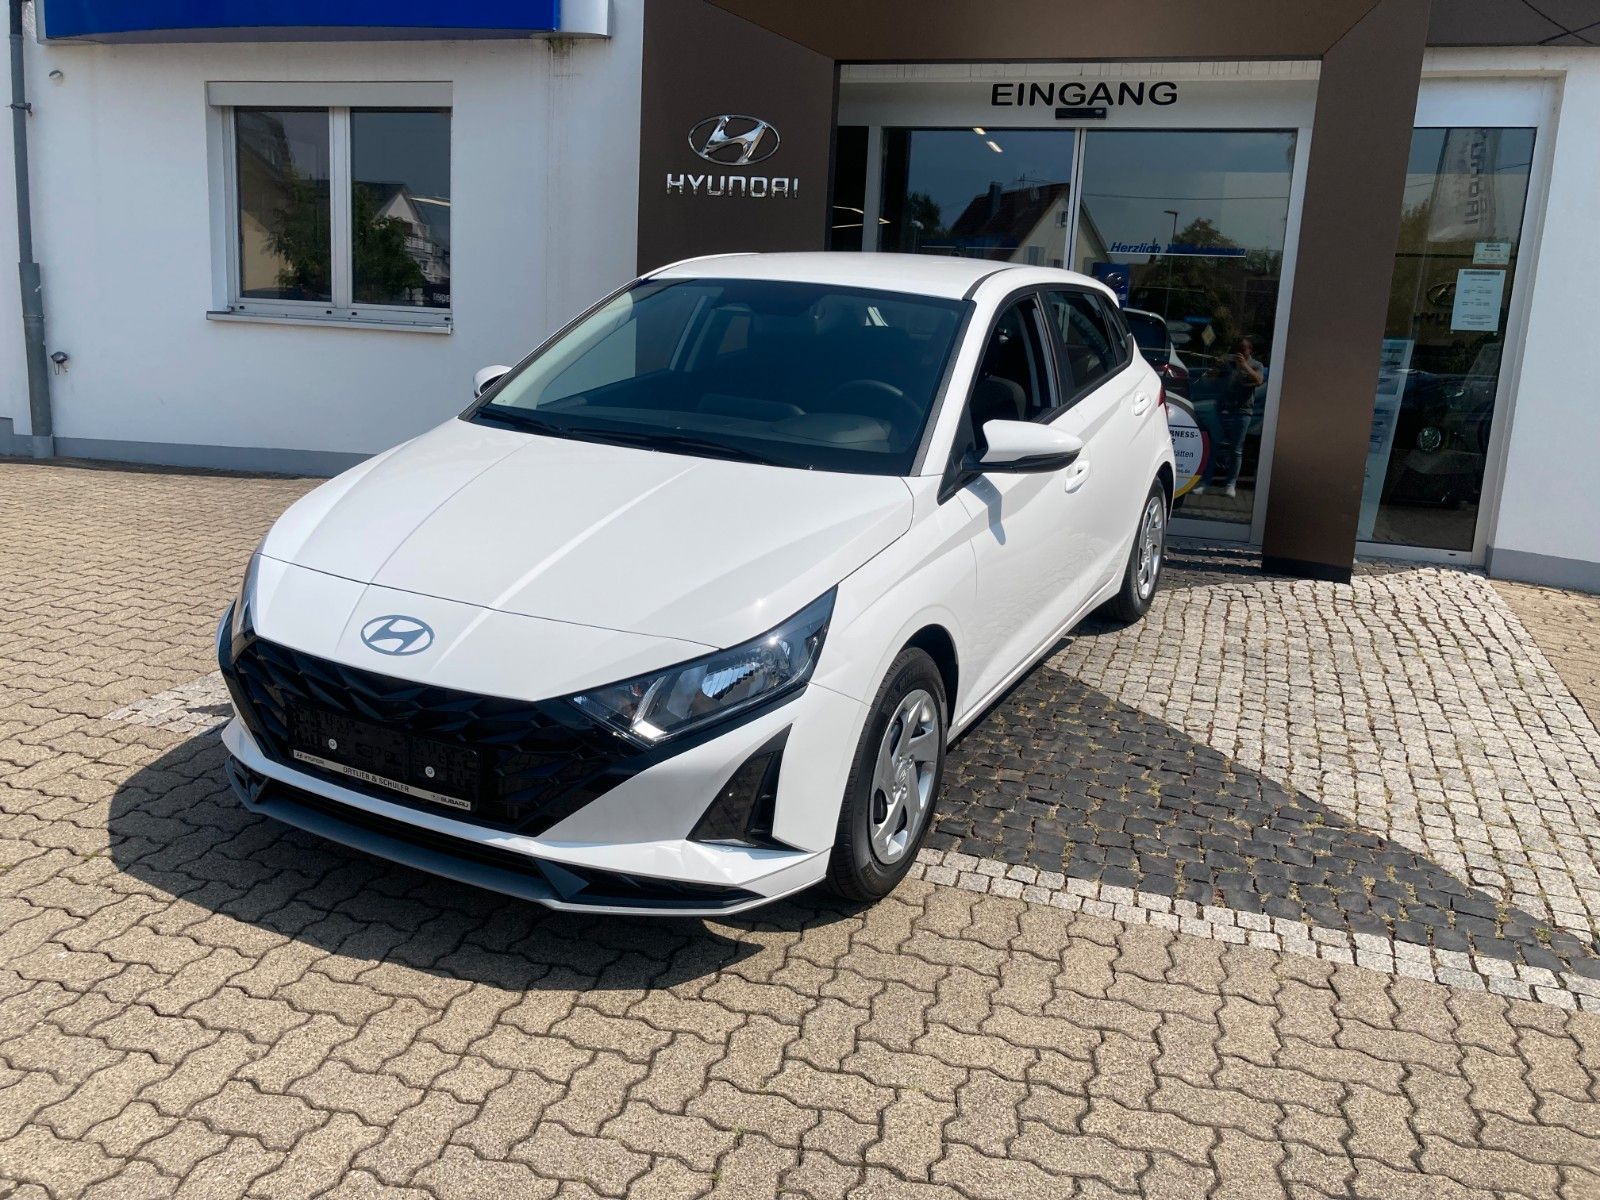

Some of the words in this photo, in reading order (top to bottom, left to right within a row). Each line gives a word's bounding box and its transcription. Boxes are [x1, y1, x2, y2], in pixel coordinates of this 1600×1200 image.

[991, 81, 1178, 107] EINGANG
[666, 173, 799, 198] HYUNDAI
[1110, 241, 1162, 254] Herzlich
[440, 797, 469, 808] SUBARU
